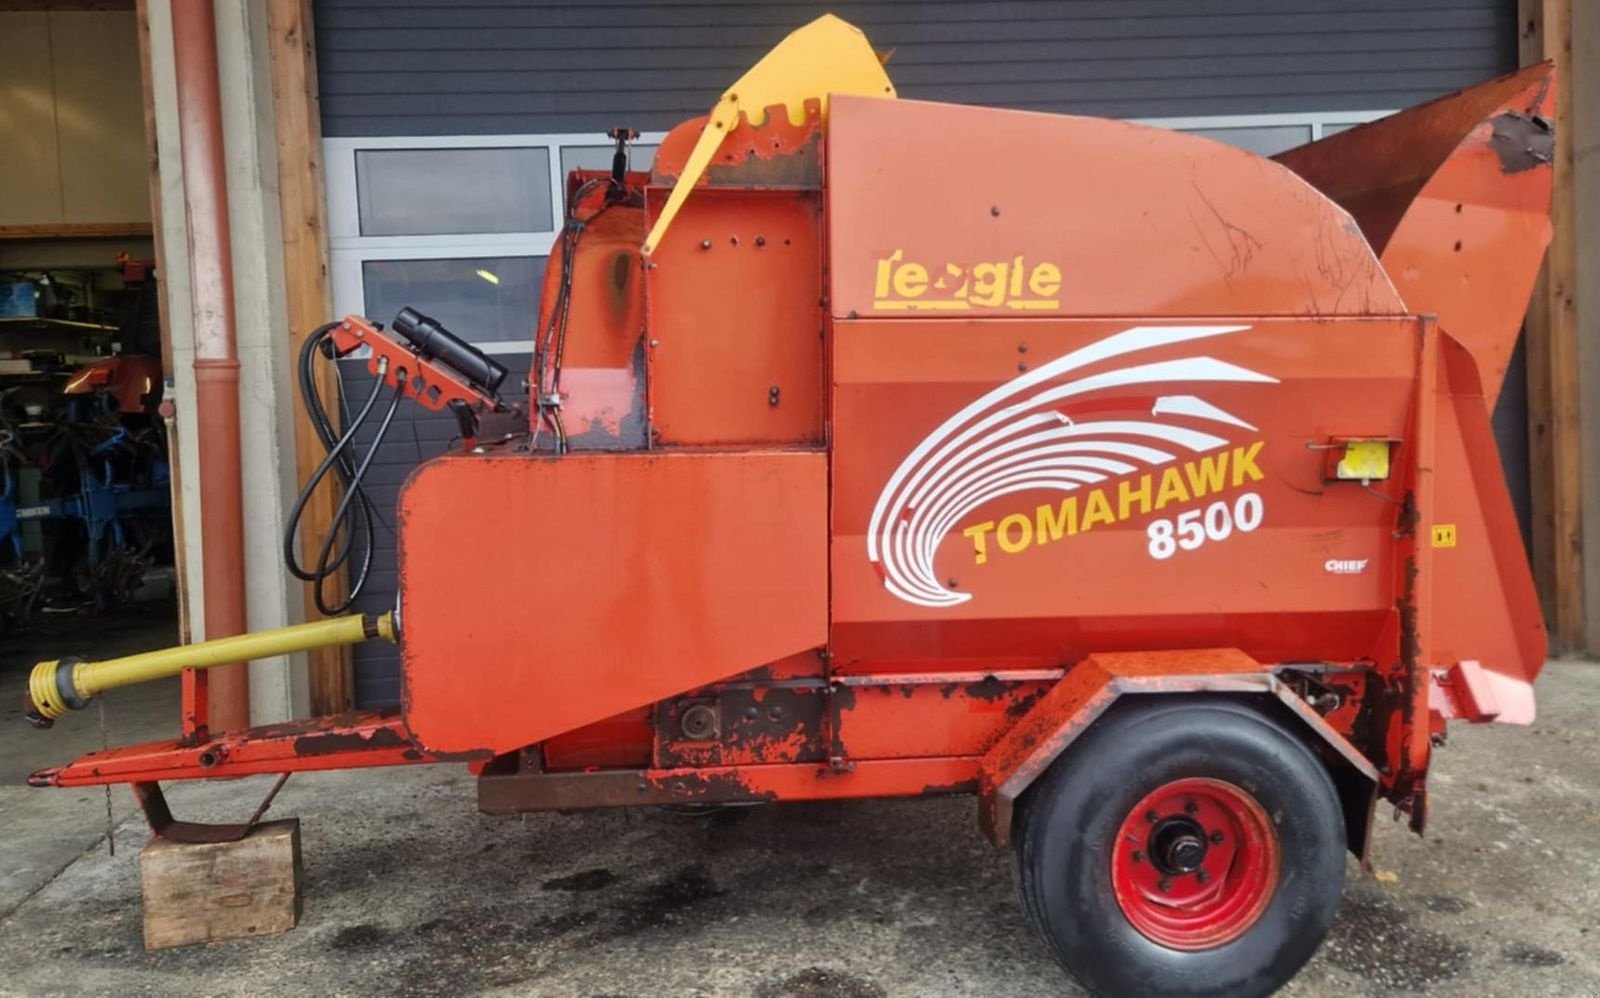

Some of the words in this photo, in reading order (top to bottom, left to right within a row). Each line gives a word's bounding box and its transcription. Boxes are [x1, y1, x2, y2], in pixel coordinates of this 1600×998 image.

[963, 441, 1265, 564] TOMAHAWK
[1147, 492, 1264, 560] 8500
[1324, 559, 1368, 574] CHIEF
